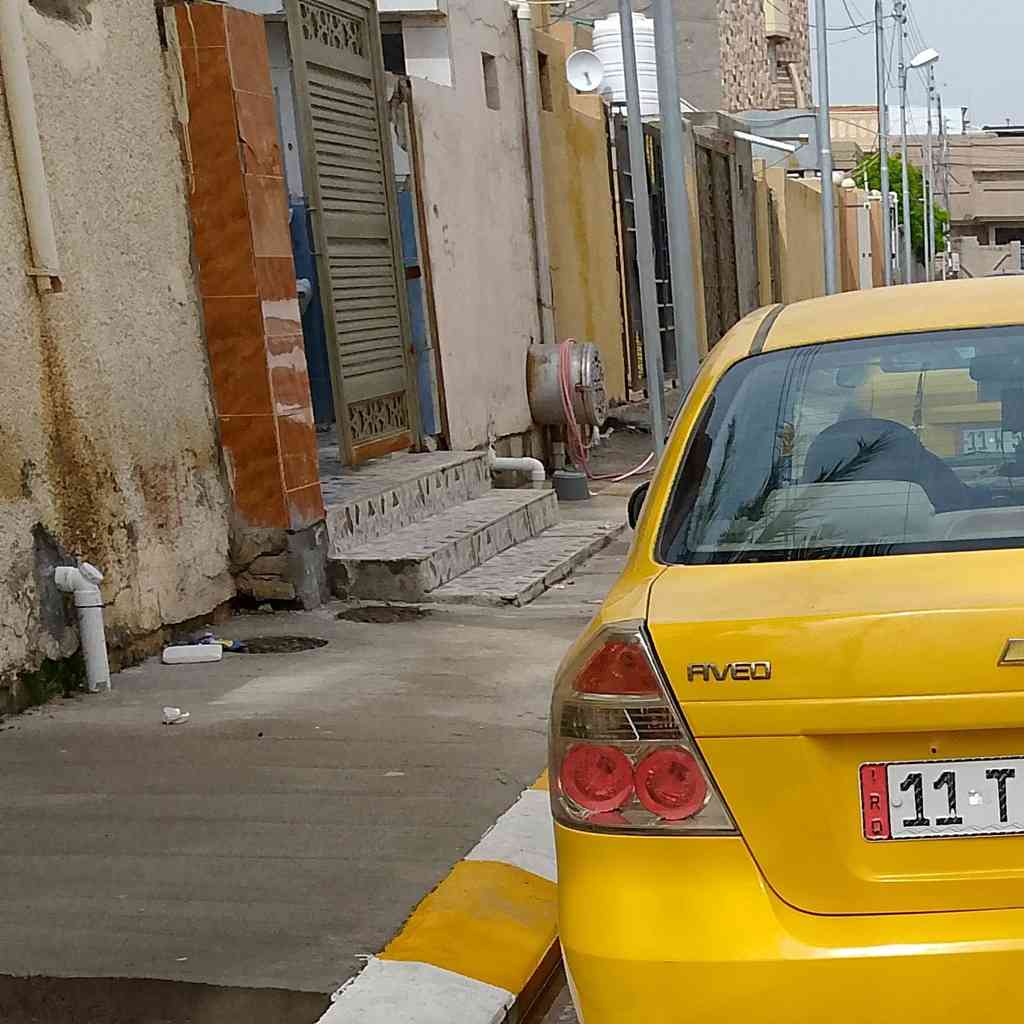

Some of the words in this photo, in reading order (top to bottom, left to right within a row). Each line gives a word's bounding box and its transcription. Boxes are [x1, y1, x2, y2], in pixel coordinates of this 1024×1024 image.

[686, 661, 772, 682] AVEO
[900, 771, 963, 828] 11
[985, 768, 1016, 823] T
